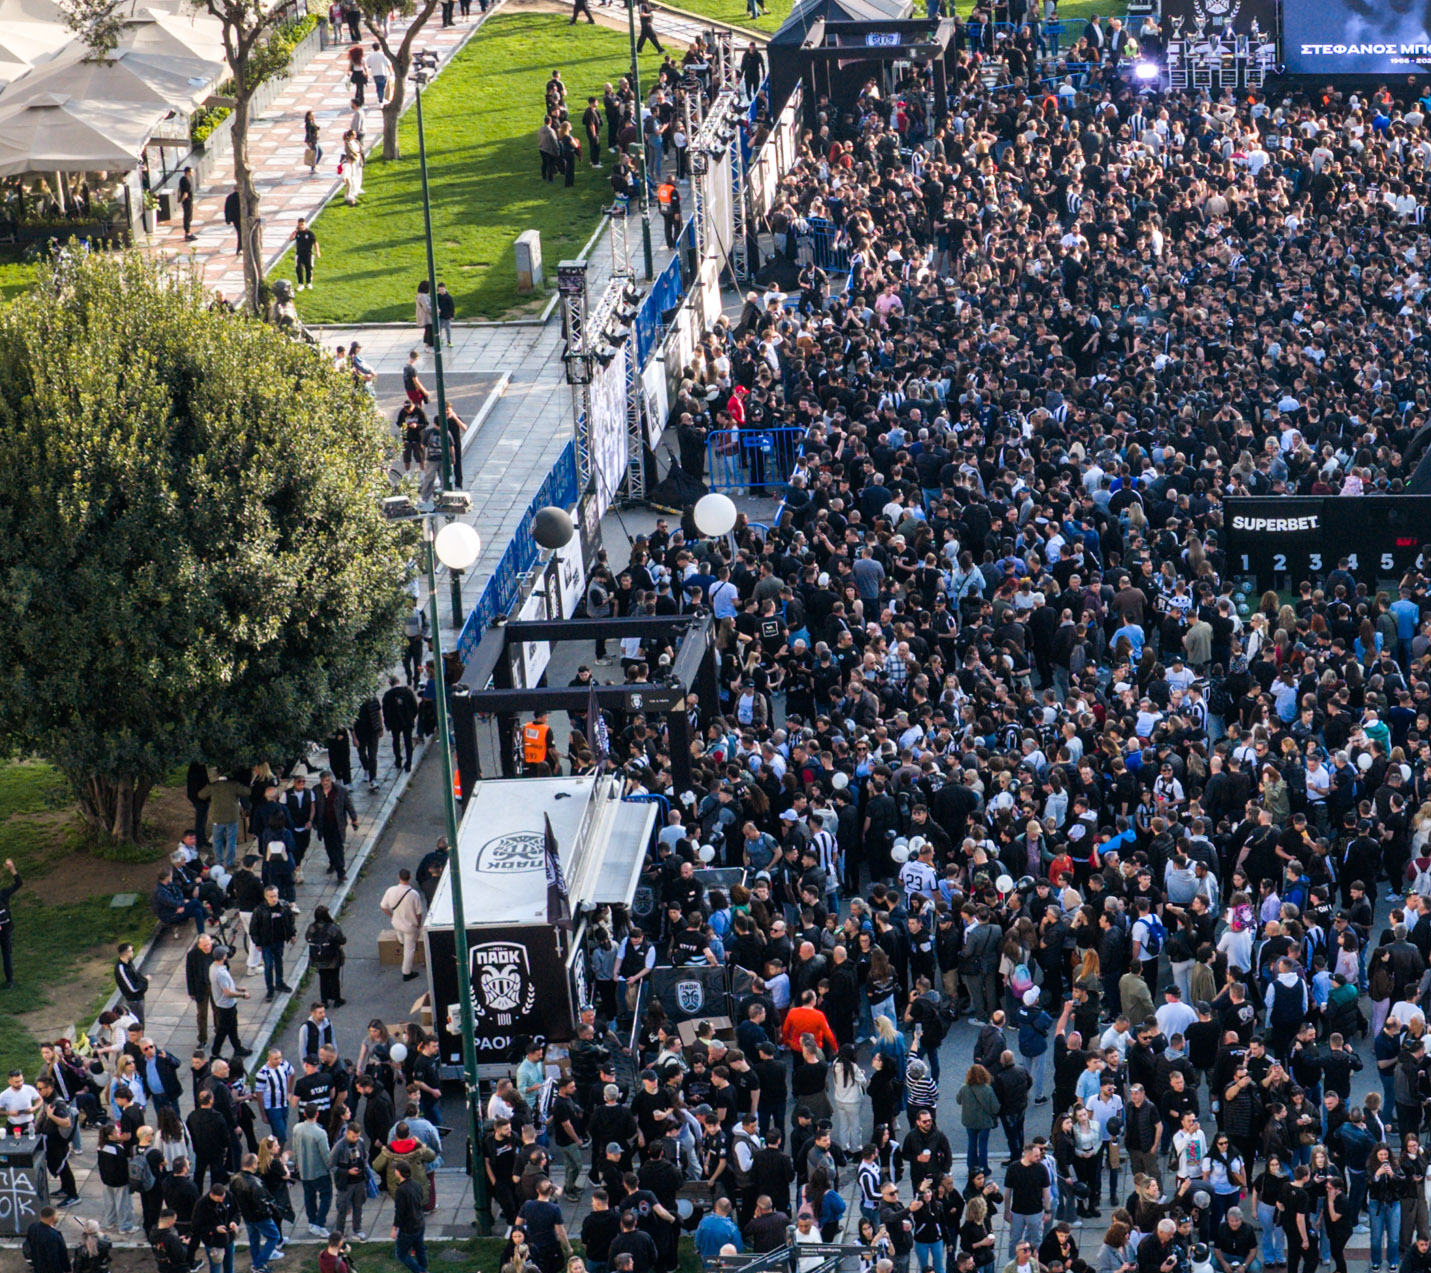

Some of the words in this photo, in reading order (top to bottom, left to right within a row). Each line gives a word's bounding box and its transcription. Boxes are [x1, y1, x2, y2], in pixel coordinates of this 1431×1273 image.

[1301, 44, 1396, 54] ΣΤΕΦΑΝΟΣ
[1232, 515, 1318, 532] SUPERBET
[1241, 554, 1249, 570] 1
[1273, 554, 1286, 570] 2
[1309, 554, 1322, 570] 3
[1348, 553, 1358, 570] 4
[1381, 553, 1394, 570] 5
[1416, 553, 1424, 569] 6
[905, 874, 924, 888] 23
[477, 951, 520, 964] ΠΑΟΚ
[310, 1085, 328, 1096] STAFF
